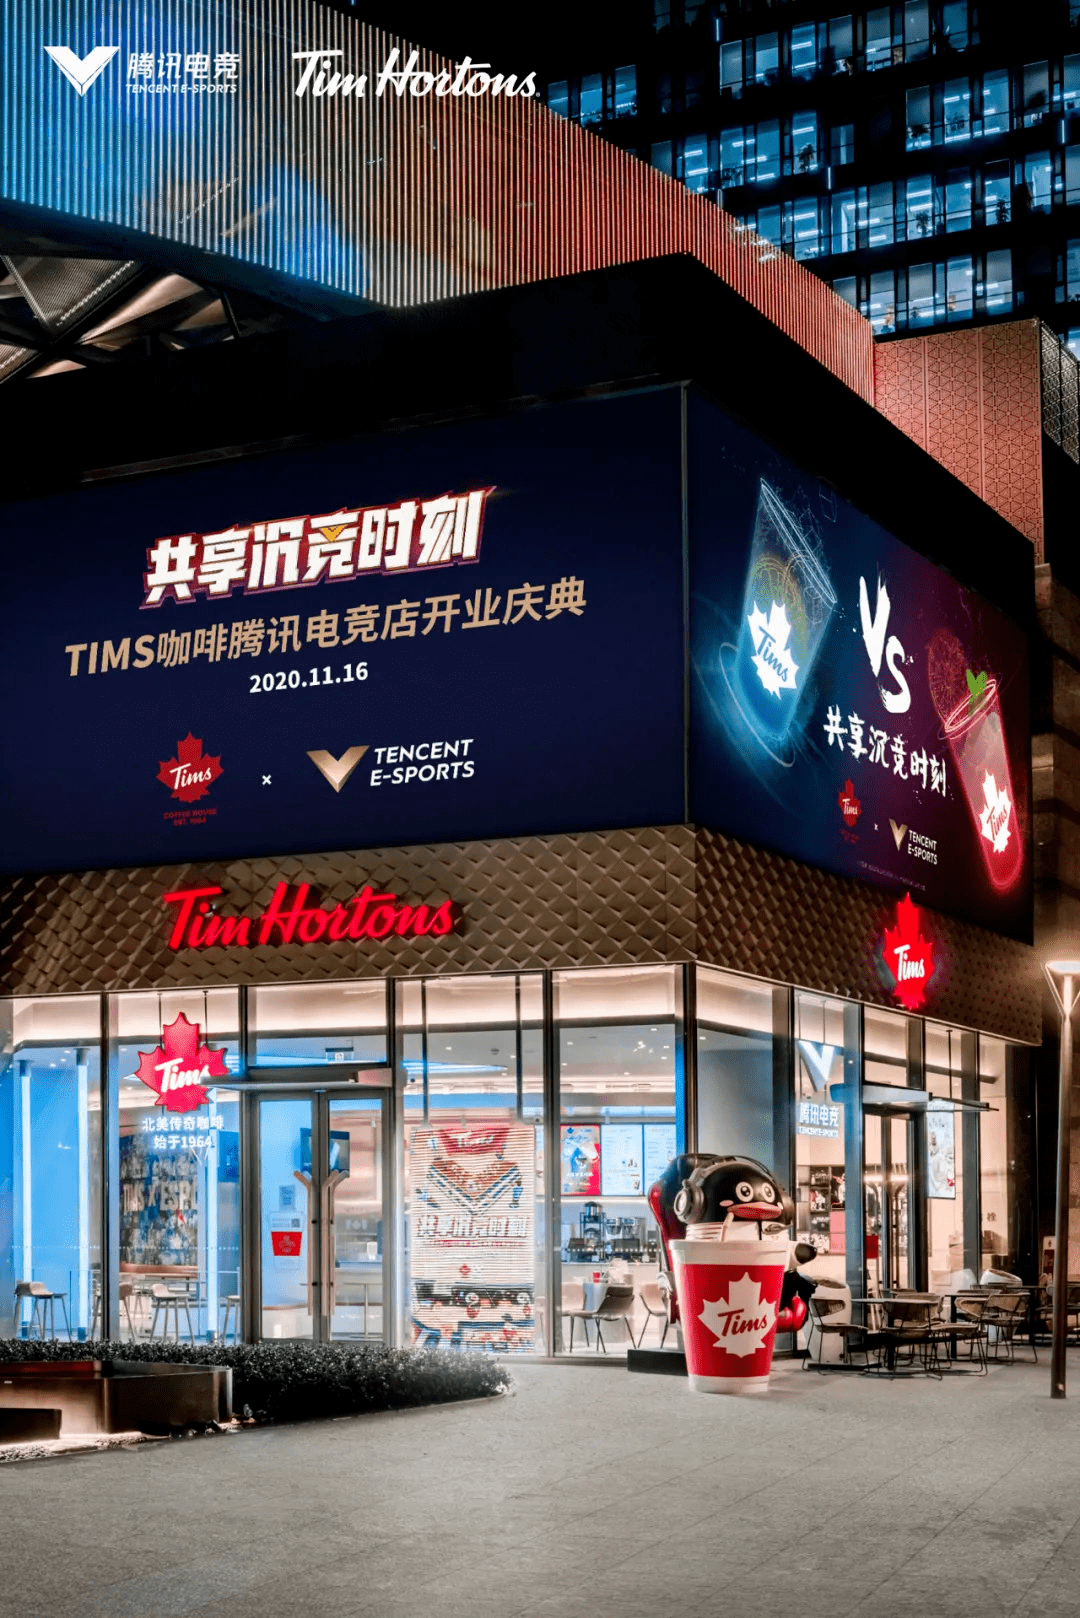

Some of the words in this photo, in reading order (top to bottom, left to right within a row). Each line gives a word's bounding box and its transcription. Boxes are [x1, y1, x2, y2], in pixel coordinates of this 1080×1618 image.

[143, 489, 488, 606] 共享沉竞时刻
[65, 575, 587, 677] TIMS咖啡腾讯电竞店开业庆典
[757, 625, 788, 682] Tims
[859, 573, 911, 714] VS
[249, 661, 369, 693] 2020.11.16
[374, 738, 474, 764] TENCENT
[823, 703, 947, 798] 共享沉竞时刻
[169, 762, 212, 790] Tims
[369, 760, 475, 787] E-SPORTS
[986, 804, 1008, 842] Tims
[907, 843, 938, 866] E-SPORTS
[908, 829, 938, 851] TENCENT
[163, 885, 249, 950] Tim
[258, 880, 454, 946] Hortons
[893, 943, 925, 982] Tims
[142, 1115, 225, 1132] 北美传奇咖啡
[153, 1135, 213, 1149] 始于1964
[717, 1308, 768, 1337] Tims
